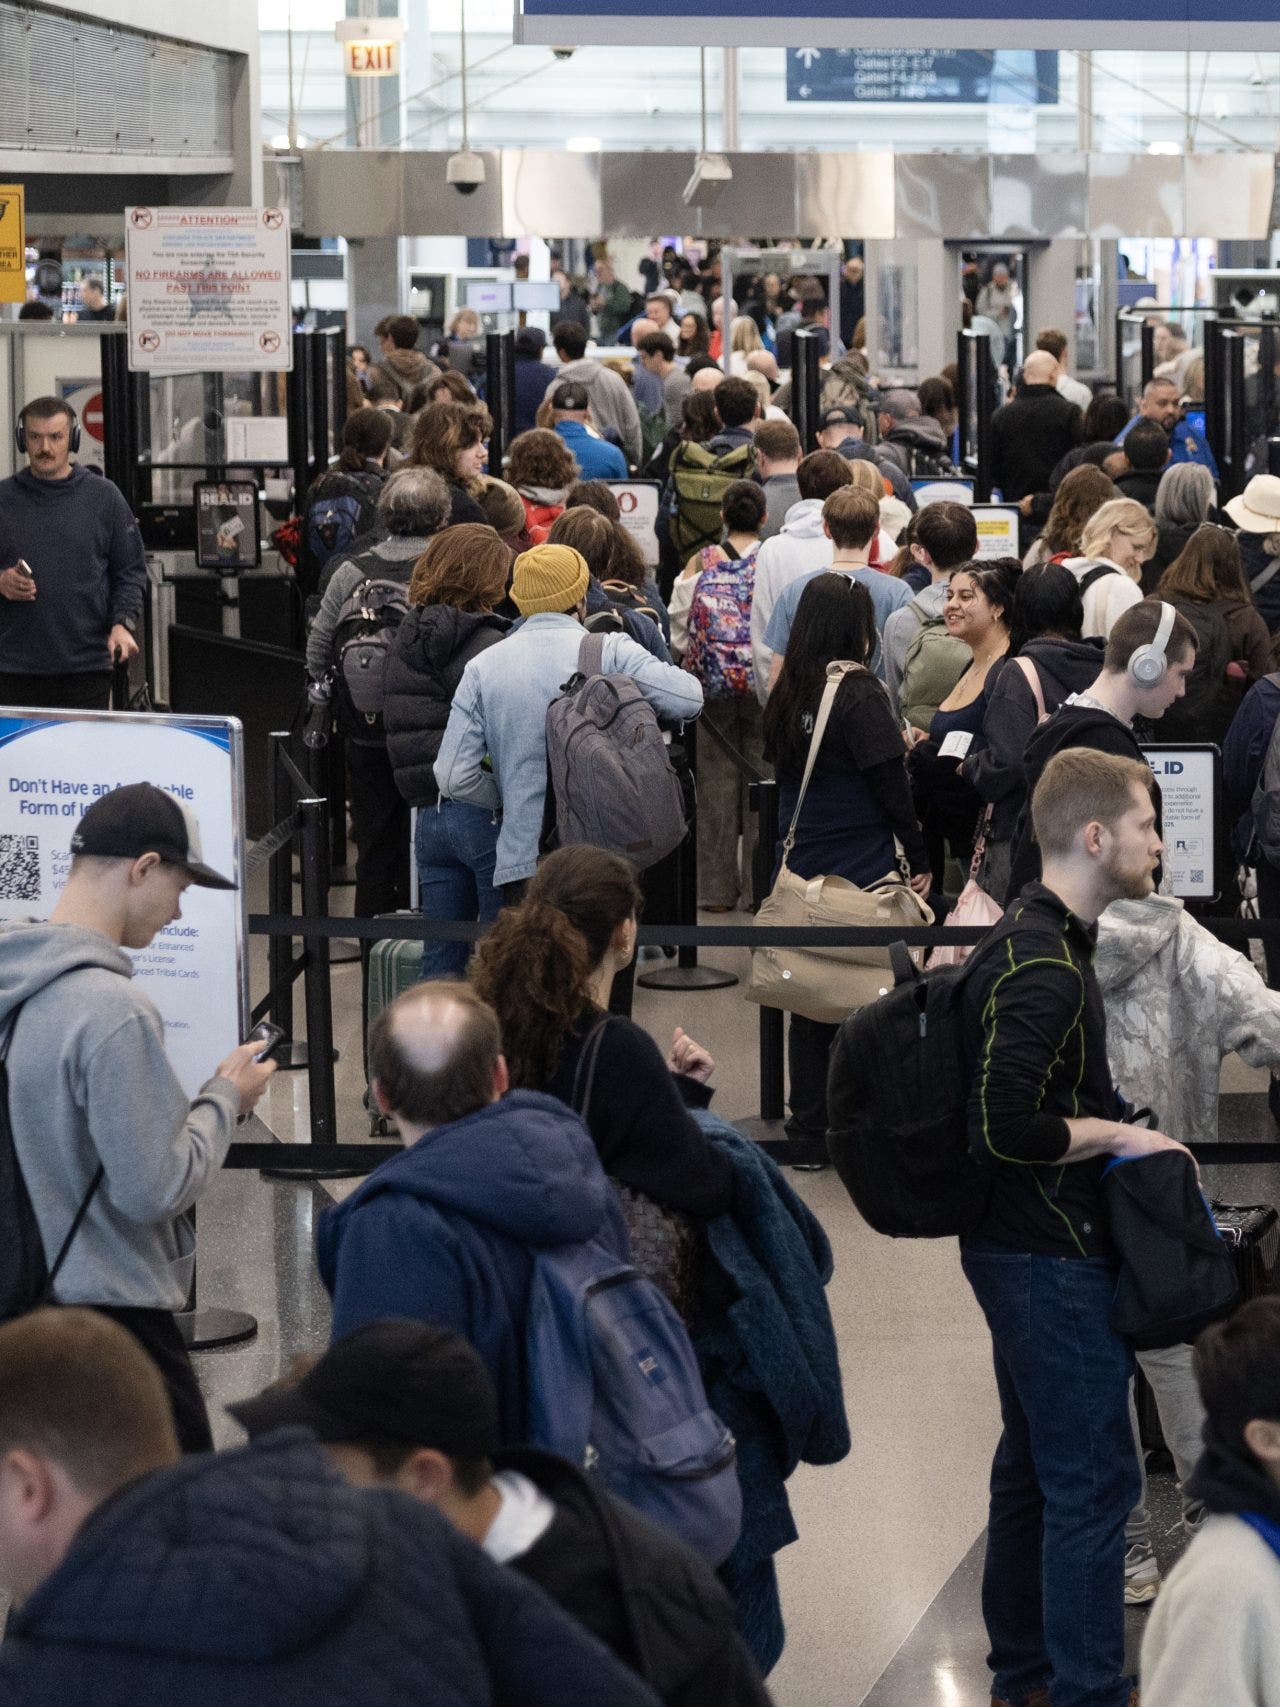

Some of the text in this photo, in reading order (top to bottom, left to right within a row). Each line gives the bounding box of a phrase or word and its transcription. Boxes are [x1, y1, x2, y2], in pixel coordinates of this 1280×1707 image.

[350, 46, 393, 70] EXIT
[854, 57, 889, 70] Gates
[854, 70, 889, 84] Gates
[854, 84, 890, 99] Gates
[180, 215, 238, 225] ATTENTION
[136, 271, 281, 281] NO FIREARMS ARE ALLOWED
[166, 283, 250, 293] PAST THIS POINT
[201, 492, 253, 506] REAL ID
[1164, 761, 1184, 774] ID
[9, 778, 48, 794] Don't
[52, 780, 88, 795] Have
[92, 784, 110, 797] an
[20, 801, 58, 816] Form
[62, 802, 77, 816] of
[158, 942, 194, 952] Enhanced
[149, 954, 176, 964] License
[156, 968, 176, 977] Tribal
[178, 970, 200, 979] Cards
